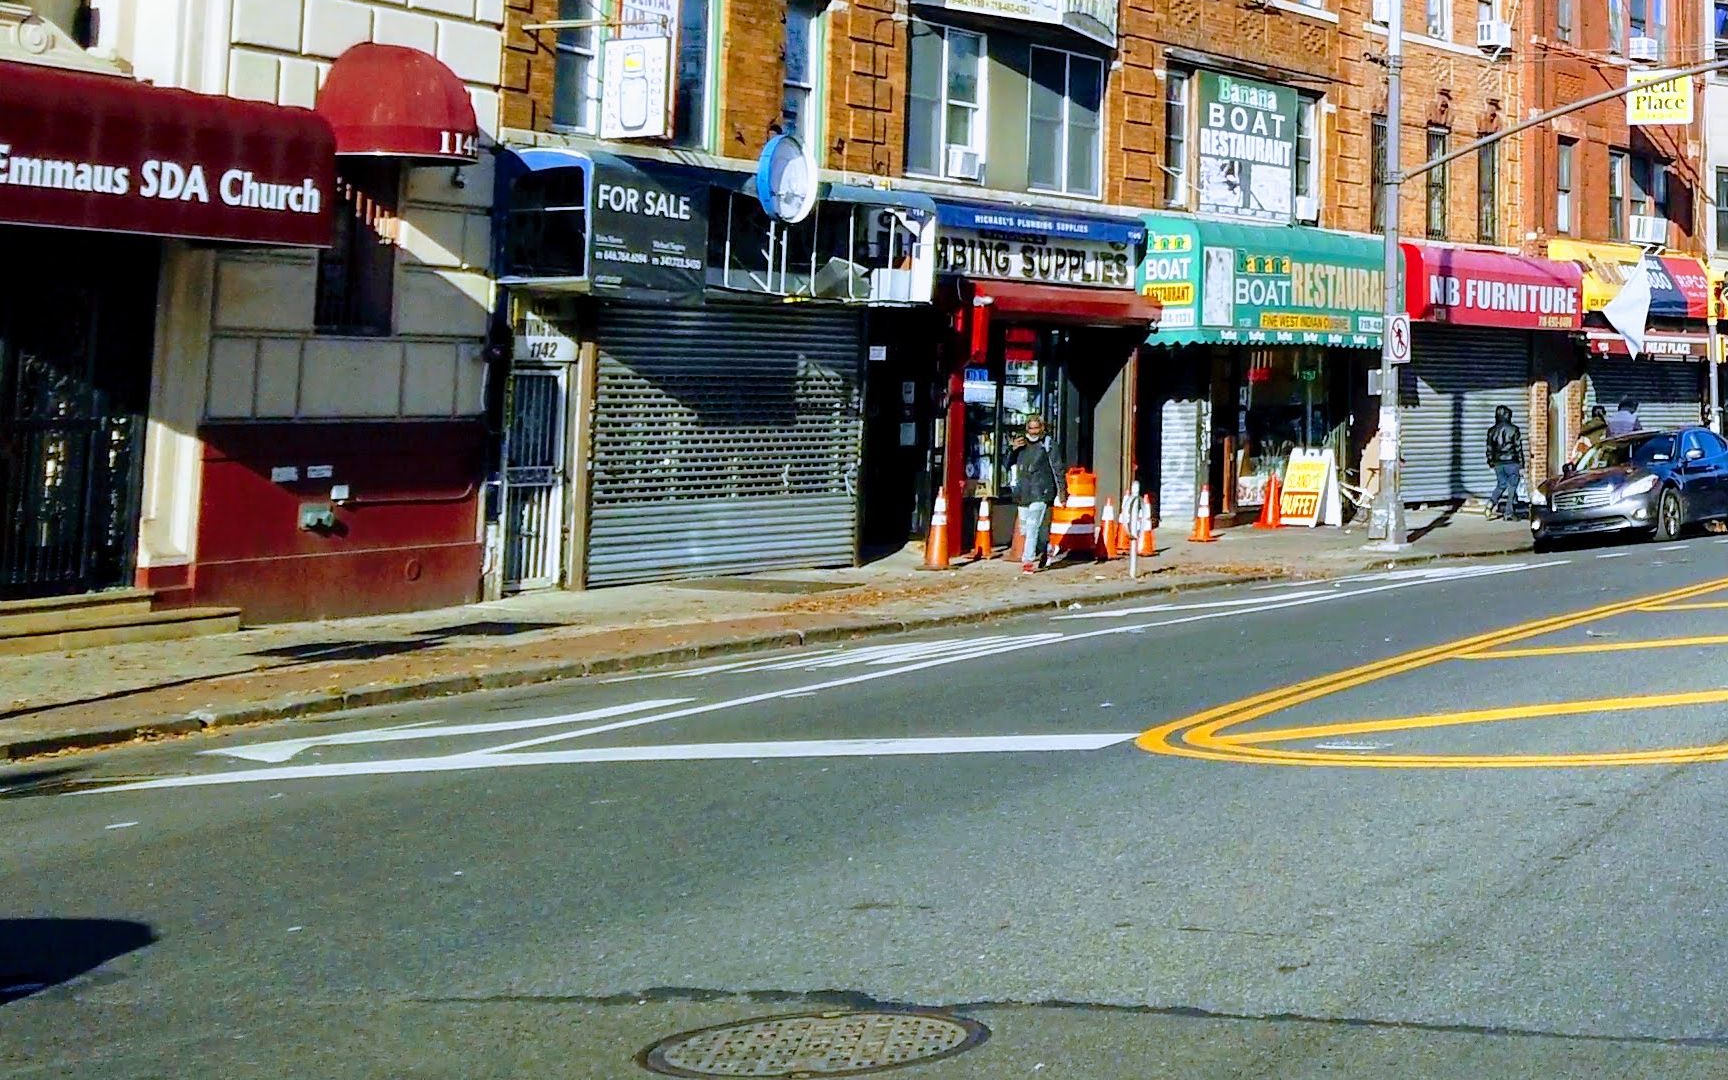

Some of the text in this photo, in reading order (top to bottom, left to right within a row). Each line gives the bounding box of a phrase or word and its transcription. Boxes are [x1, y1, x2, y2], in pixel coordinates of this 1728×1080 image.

[1218, 75, 1278, 112] Banana
[1636, 95, 1685, 110] Place
[1208, 102, 1286, 138] BOAT
[440, 130, 478, 156] 114
[1200, 127, 1293, 167] RESTAURANT
[0, 144, 321, 214] Emmaus SDA Church
[598, 183, 691, 220] FOR SALE
[974, 214, 1014, 227] MICHAEL'S
[1056, 222, 1088, 234] SUPPLIES
[1019, 244, 1128, 286] SUPPLIES
[1145, 257, 1192, 281] BOAT
[1236, 249, 1292, 276] Banana
[1235, 278, 1292, 306] BOAT
[1291, 263, 1385, 312] RESTAURA
[1429, 275, 1578, 315] NB FURNITURE
[1262, 314, 1279, 328] FINE
[1279, 315, 1299, 328] WEST
[530, 342, 558, 359] 1142
[1667, 343, 1690, 354] PLACE
[1281, 494, 1318, 515] BUFFET
